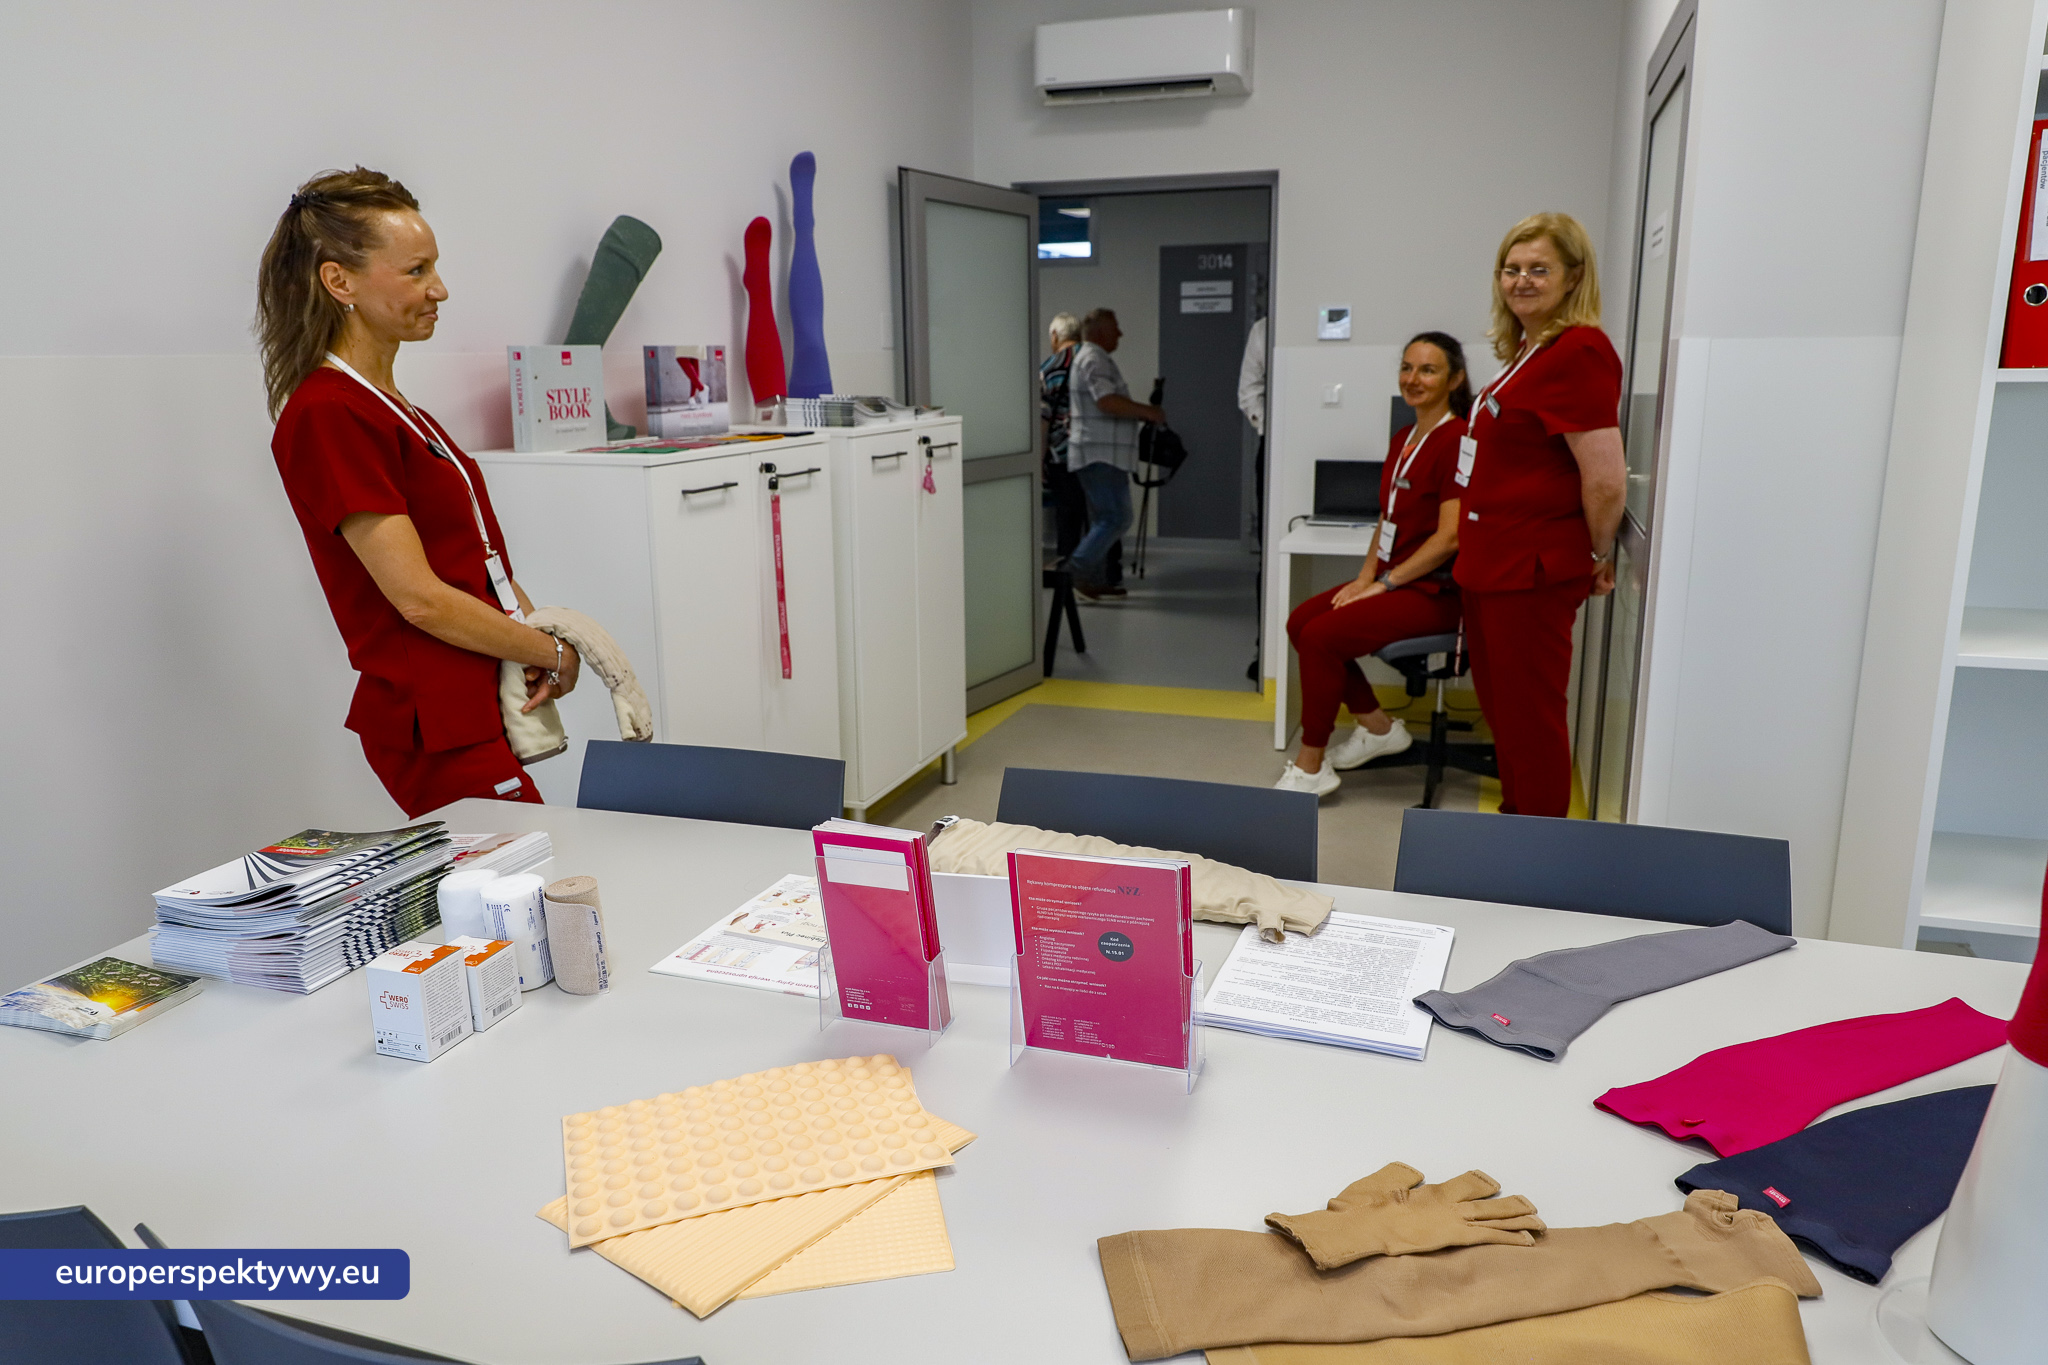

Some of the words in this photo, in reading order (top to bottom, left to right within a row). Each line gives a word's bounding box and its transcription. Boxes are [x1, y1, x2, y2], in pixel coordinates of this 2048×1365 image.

[1198, 253, 1234, 270] 3014
[546, 387, 592, 405] STYLE
[549, 402, 592, 421] BOOK
[1117, 886, 1141, 896] NFZ
[706, 969, 748, 978] uproszczona
[388, 994, 409, 1004] WERO
[389, 1001, 409, 1010] SWISS
